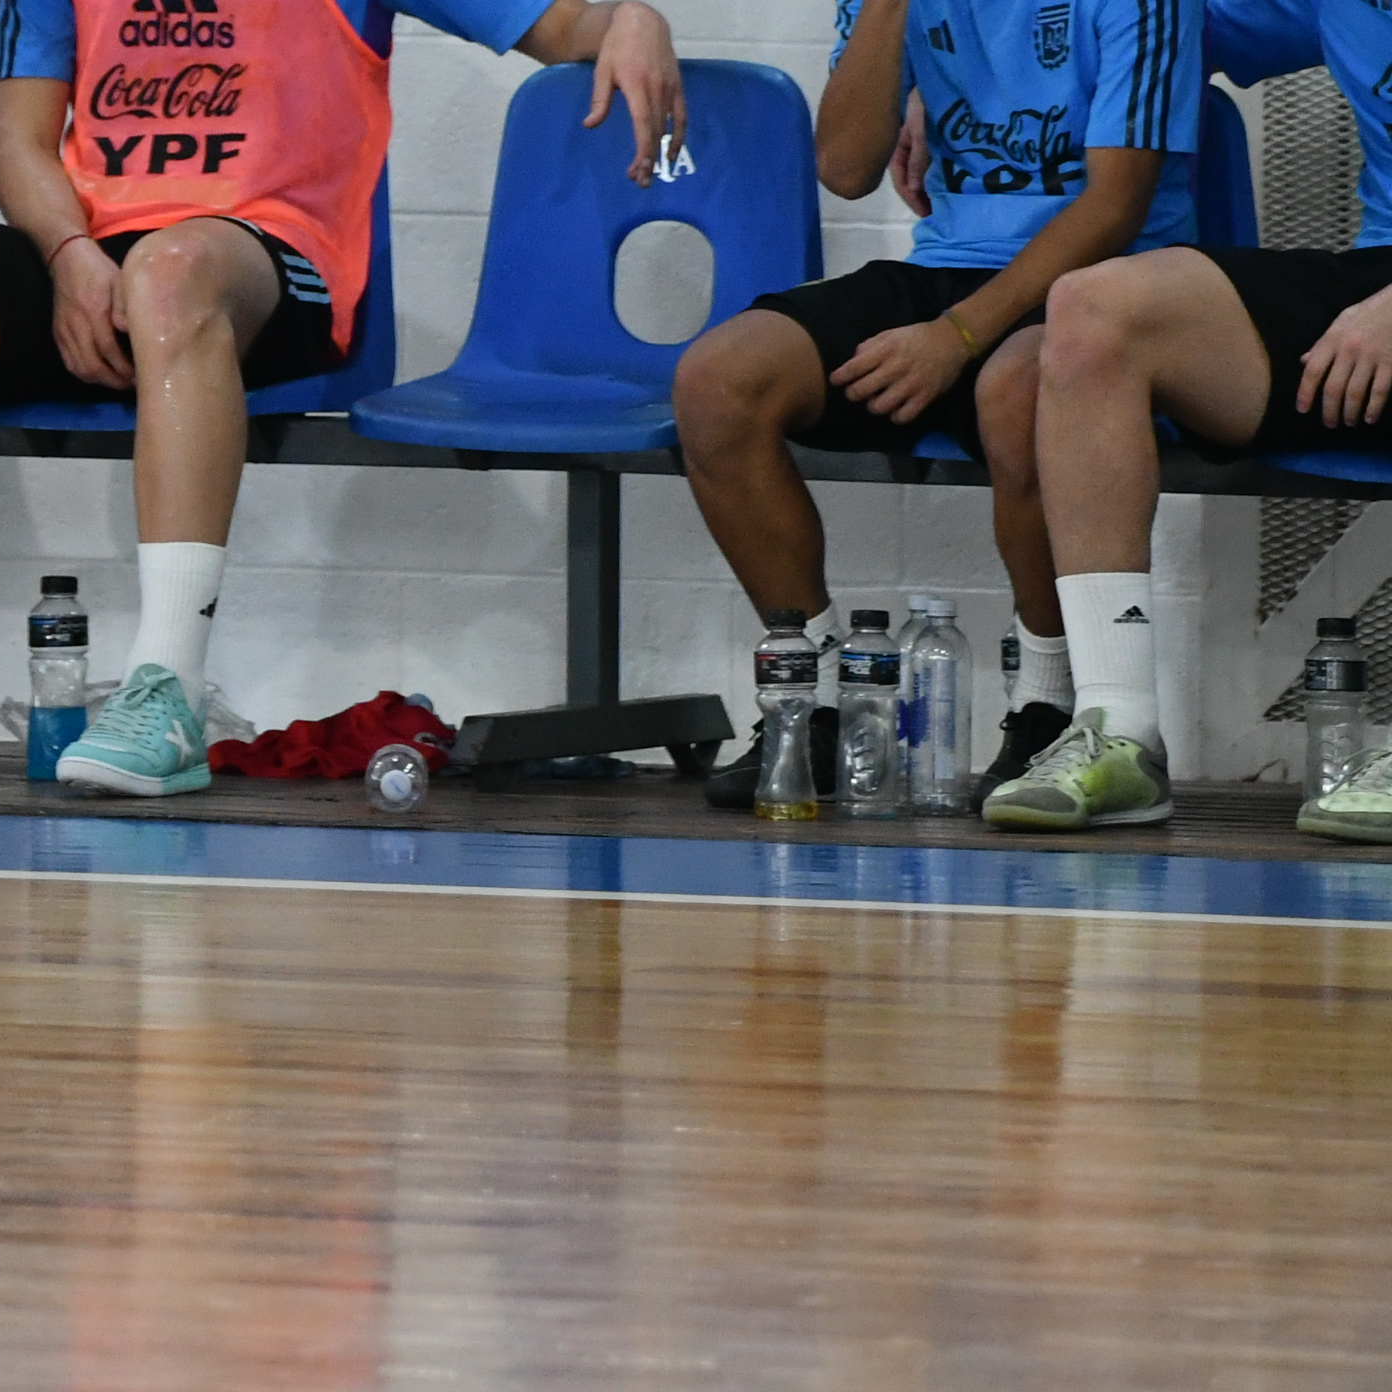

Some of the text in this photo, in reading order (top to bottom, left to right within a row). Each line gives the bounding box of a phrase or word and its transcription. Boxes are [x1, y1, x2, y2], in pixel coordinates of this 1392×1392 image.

[119, 13, 235, 48] adidas
[88, 63, 249, 121] Coca-Cola
[93, 132, 247, 177] YPF
